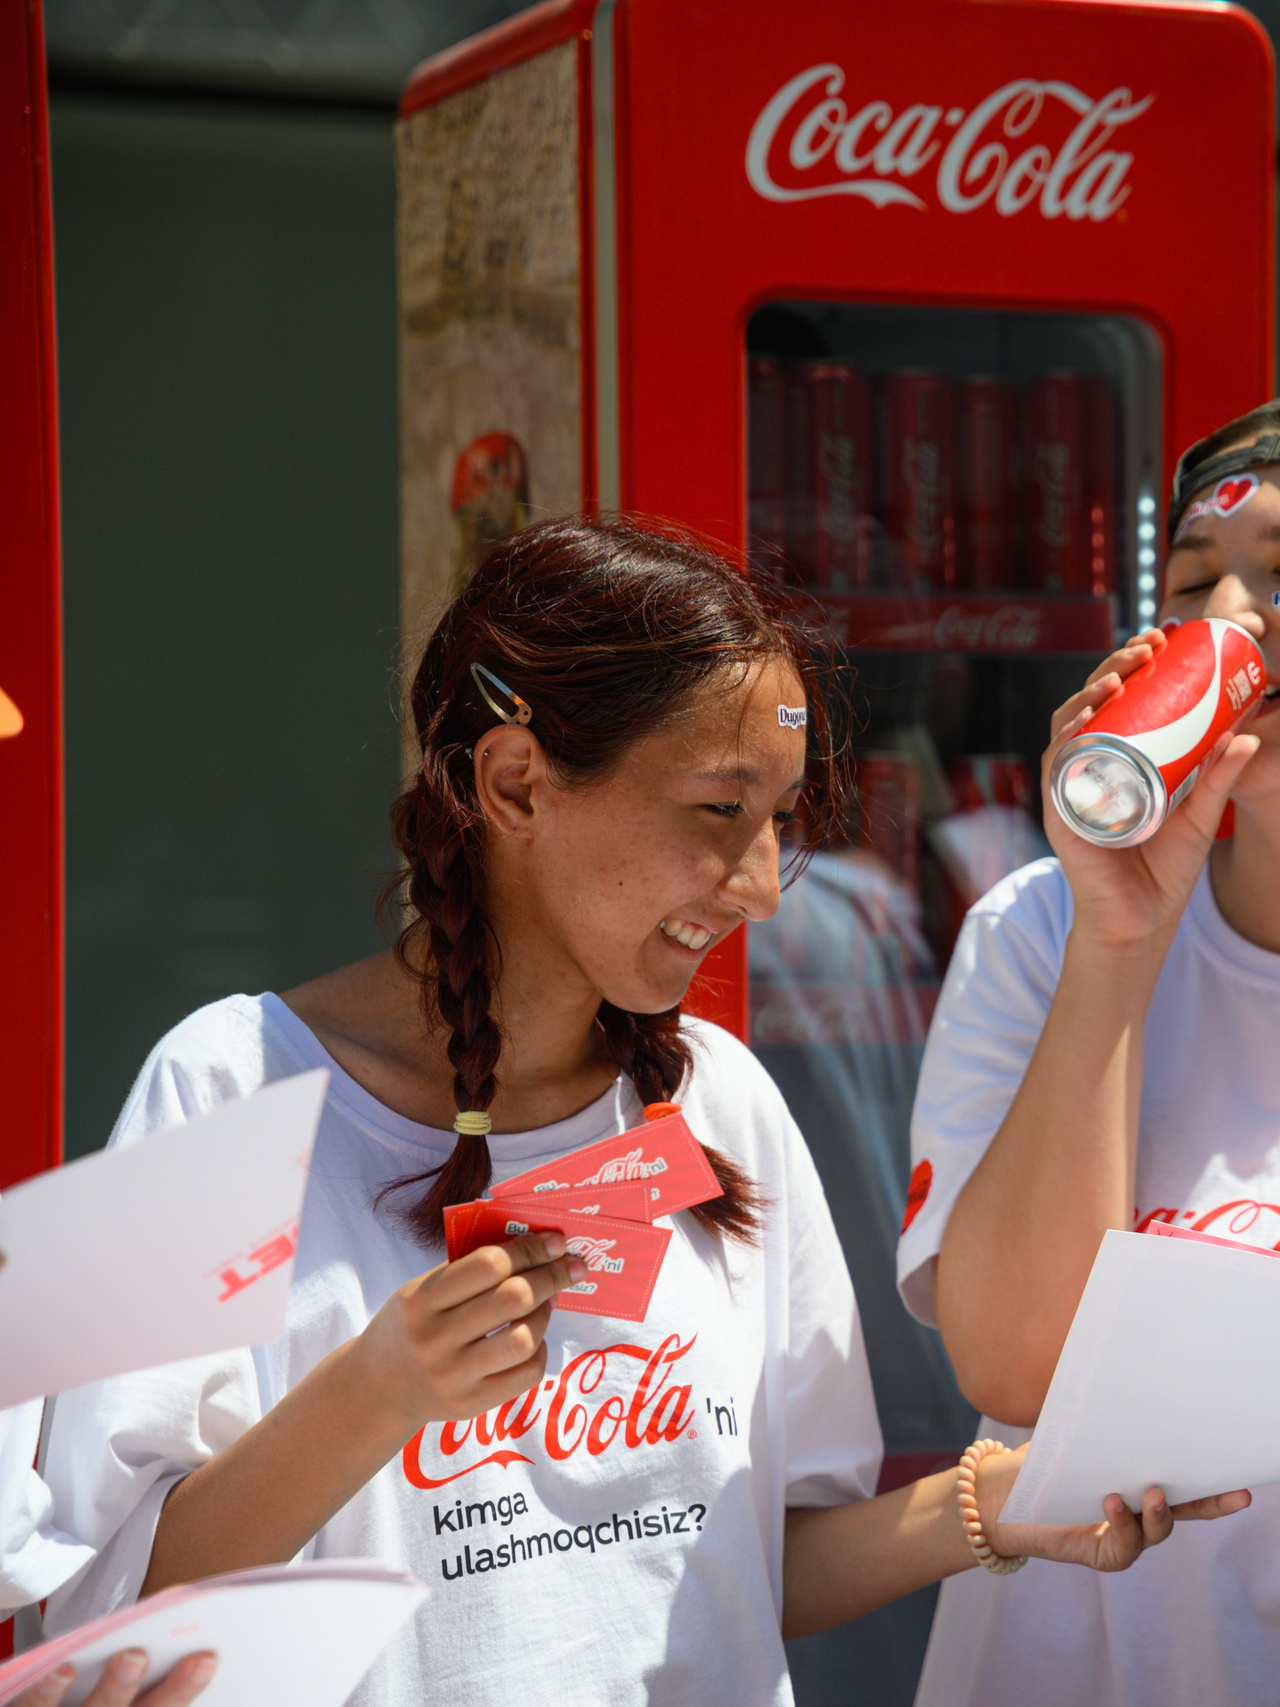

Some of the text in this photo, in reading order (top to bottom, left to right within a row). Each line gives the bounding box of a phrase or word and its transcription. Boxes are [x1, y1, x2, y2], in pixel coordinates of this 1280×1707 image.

[745, 63, 1156, 221] Coca-Cola
[780, 708, 805, 726] Dugon
[507, 1223, 528, 1234] Bu
[705, 1397, 738, 1437] 'ni
[433, 1491, 529, 1535] kimga
[441, 1503, 707, 1580] ulashmoqchisiz?
